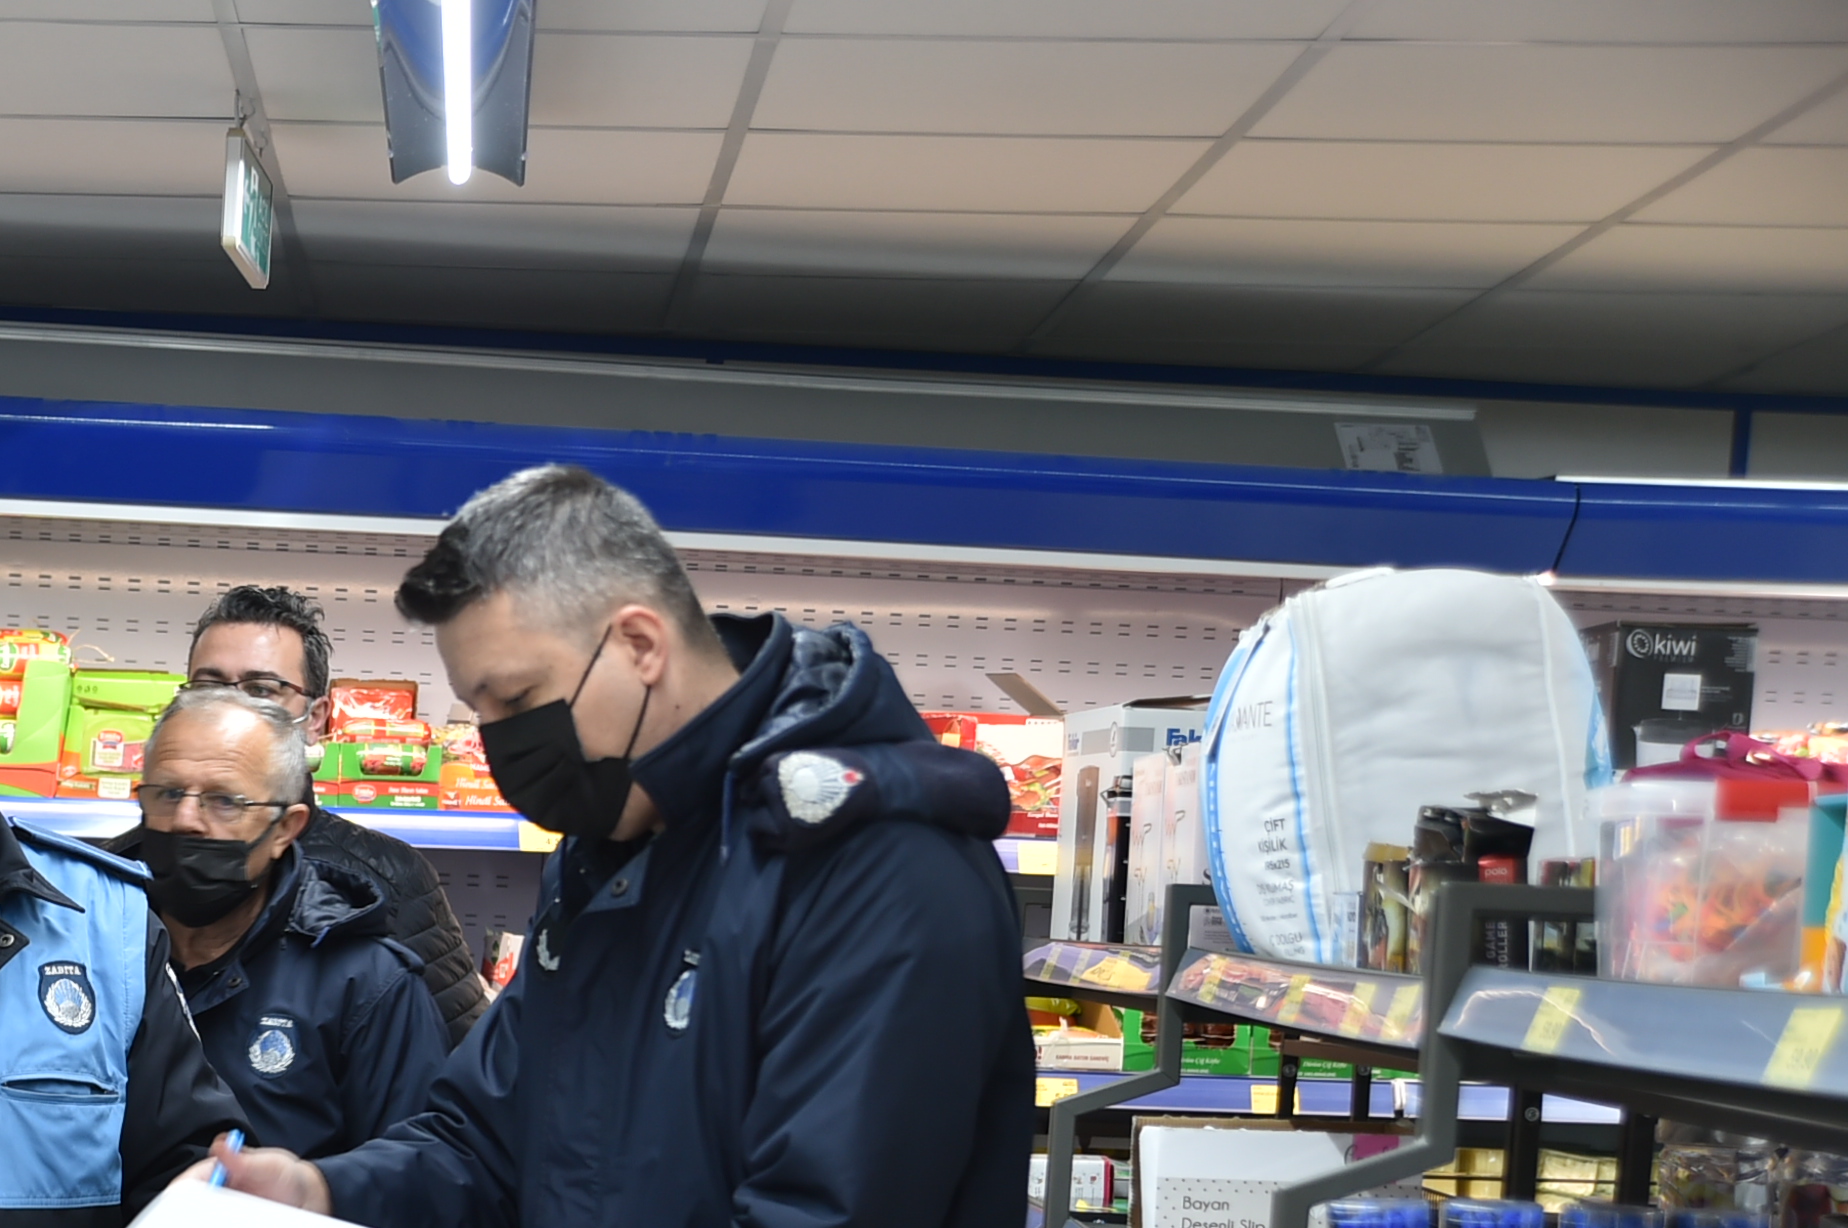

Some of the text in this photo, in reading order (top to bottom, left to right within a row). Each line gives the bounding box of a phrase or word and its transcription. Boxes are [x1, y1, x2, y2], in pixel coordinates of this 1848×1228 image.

[1654, 632, 1697, 657] kiwi
[1166, 727, 1203, 747] Fak
[1264, 816, 1286, 833] ÇİFT
[1258, 834, 1287, 855] KİŞİLİK
[1485, 921, 1497, 959] GAME
[44, 965, 81, 977] ZABITA
[1182, 1195, 1231, 1214] Bayan
